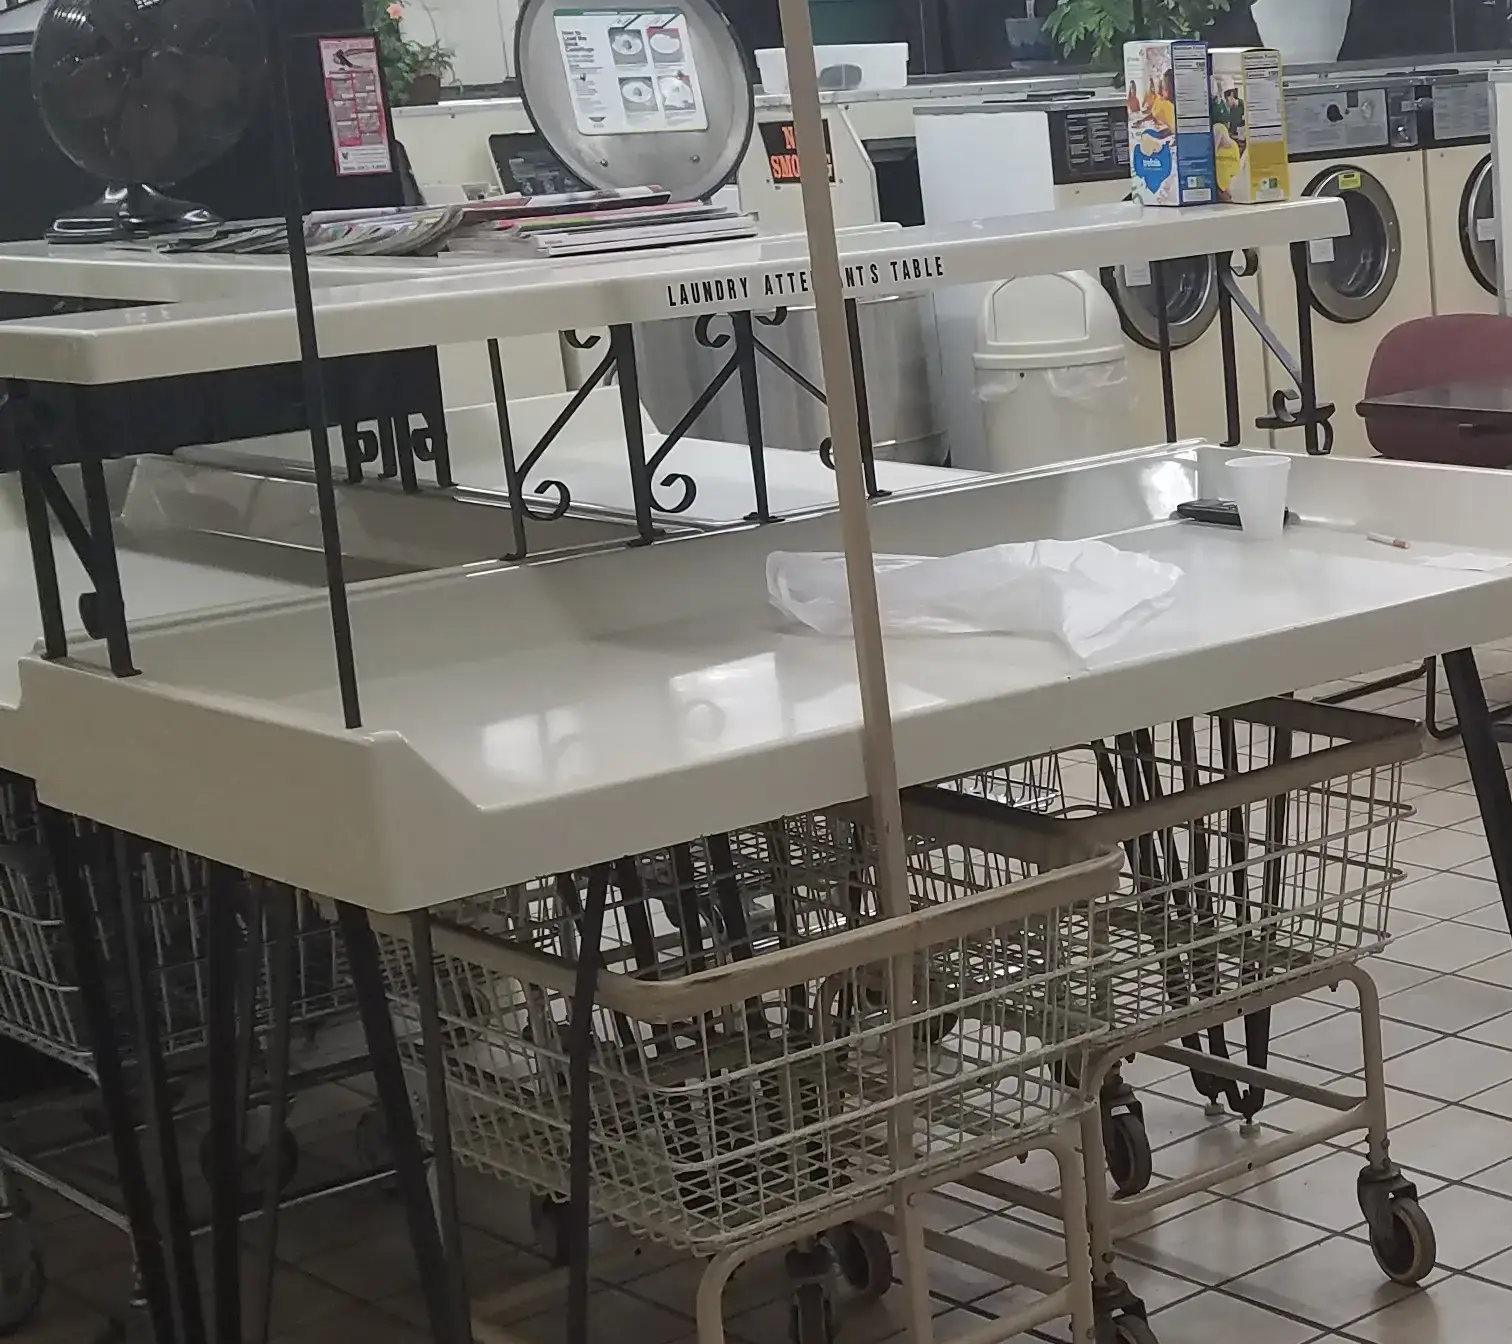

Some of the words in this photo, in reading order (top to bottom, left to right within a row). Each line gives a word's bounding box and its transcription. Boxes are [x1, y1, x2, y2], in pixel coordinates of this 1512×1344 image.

[667, 276, 749, 307] LAUNDRY
[764, 263, 879, 296] ATTENTS
[890, 256, 944, 282] TABLE
